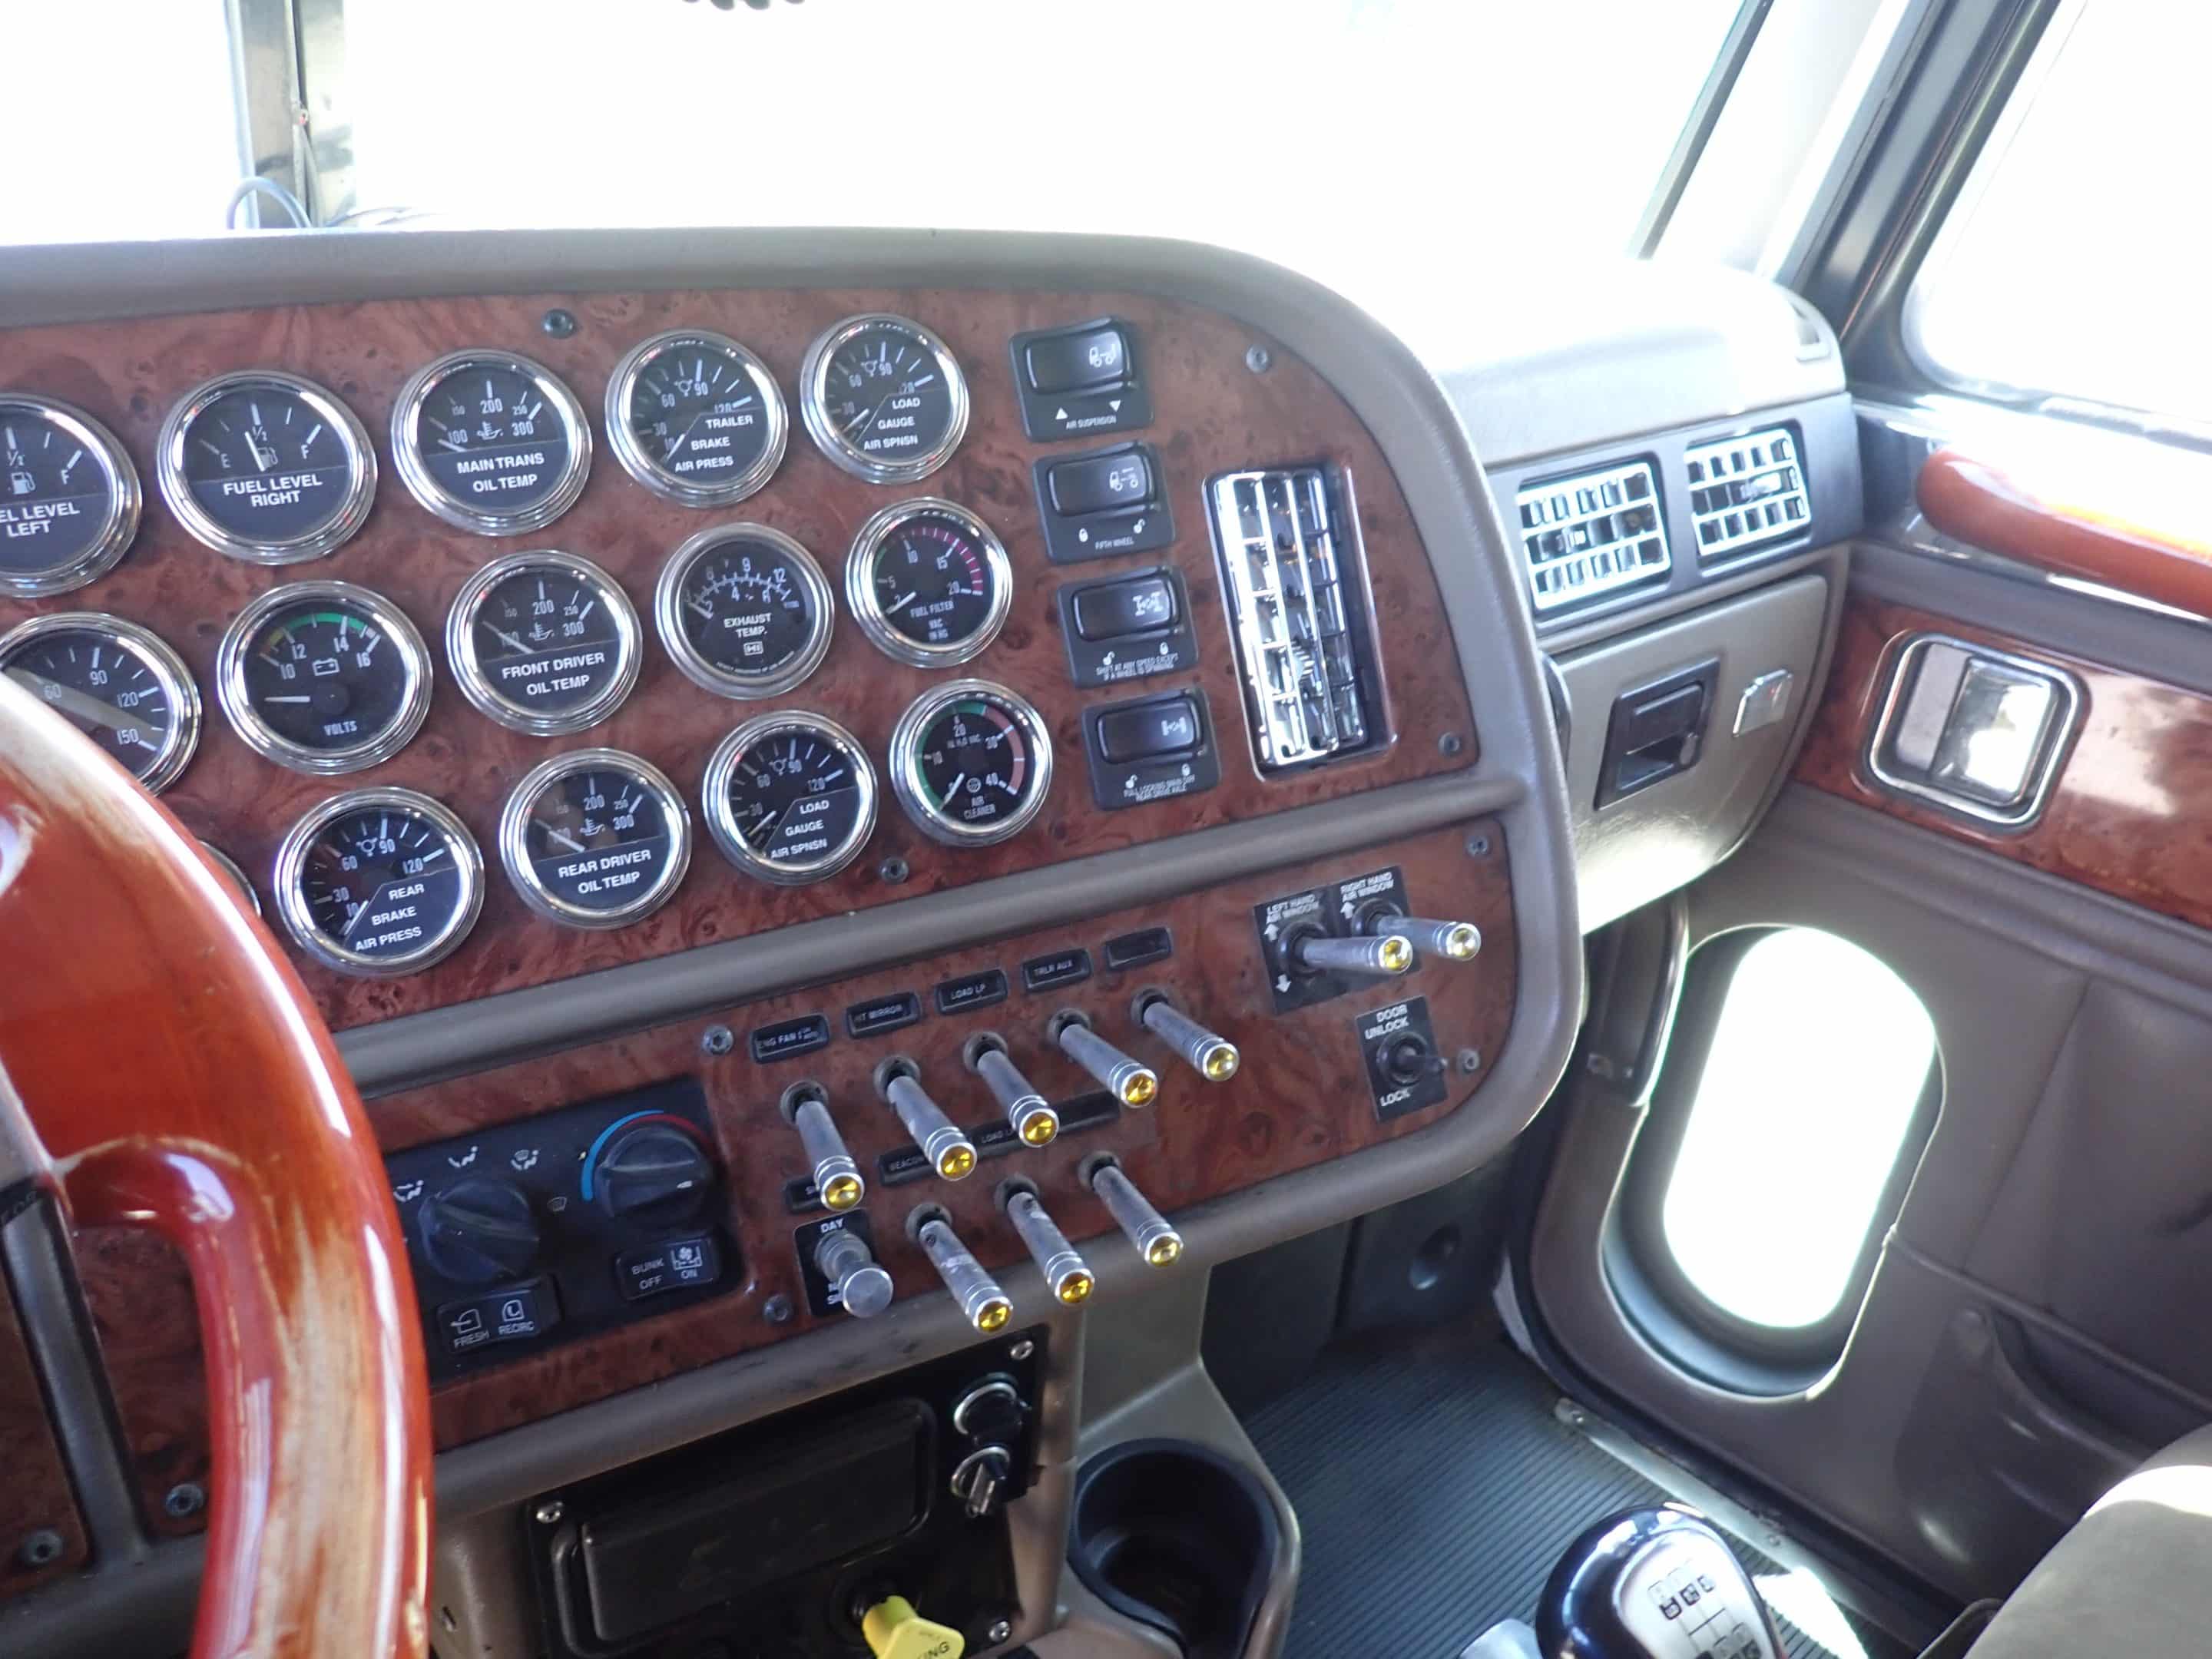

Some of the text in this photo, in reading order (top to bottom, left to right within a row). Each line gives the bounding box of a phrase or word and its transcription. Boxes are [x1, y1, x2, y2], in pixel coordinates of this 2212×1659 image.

[879, 362, 892, 376] 90
[694, 382, 708, 396] 90
[480, 398, 503, 414] 200
[661, 393, 675, 408] 60
[892, 397, 920, 409] LOAD
[512, 420, 534, 436] 300
[705, 415, 753, 429] TRAILER
[878, 416, 916, 430] GAUGE
[448, 429, 468, 444] 100
[691, 436, 730, 450] BRAKE
[864, 439, 881, 450] AIR
[301, 444, 309, 459] F
[221, 453, 230, 469] E
[457, 452, 545, 473] MAIN TRANS
[675, 456, 733, 472] AIR PRESS
[61, 469, 69, 485] F
[224, 474, 323, 495] FUEL LEVEL
[472, 474, 538, 492] OIL TEMP
[250, 490, 300, 507] RIGHT
[22, 502, 80, 520] LEVEL
[7, 520, 51, 538] LEFT
[532, 600, 555, 615] 200
[910, 600, 954, 618] FUEL FILTER
[724, 613, 772, 628] EXHAUST
[562, 621, 584, 637] 300
[736, 626, 767, 638] TEMP.
[292, 644, 306, 660] 12
[333, 637, 349, 652] 14
[356, 653, 372, 667] 16
[502, 652, 605, 679] FRONT DRIVER
[90, 670, 108, 685] 90
[280, 664, 296, 679] 10
[44, 684, 61, 699] 60
[526, 674, 590, 695] OIL TEMP
[117, 691, 139, 707] 120
[118, 728, 139, 744] 150
[324, 720, 358, 736] VOLTS
[584, 794, 605, 810] 200
[800, 800, 830, 814] LOAD
[963, 803, 995, 820] CLEANER
[613, 814, 634, 830] 300
[785, 820, 824, 837] GAUGE
[379, 838, 396, 854] 90
[770, 839, 827, 859] AIR SPNSN
[342, 856, 358, 871] 60
[402, 857, 423, 874] 120
[558, 849, 651, 878] REAR DRIVER
[578, 871, 640, 894] OIL TEMP
[1358, 879, 1395, 898] WINDOW
[332, 886, 349, 903] 30
[389, 884, 425, 901] REAR
[371, 906, 417, 926] BRAKE
[1267, 902, 1288, 915] LEFT
[356, 926, 422, 952] AIR PRESS
[951, 988, 974, 1000] LOAD
[1376, 1004, 1408, 1023] DOOR
[1365, 1018, 1409, 1039] UNLOCK
[1379, 1088, 1411, 1107] LOCK
[820, 1217, 844, 1233] DAY
[631, 1258, 664, 1275] BUNK
[680, 1269, 697, 1279] ON
[639, 1274, 663, 1290] OFF
[454, 1330, 489, 1348] FRESH
